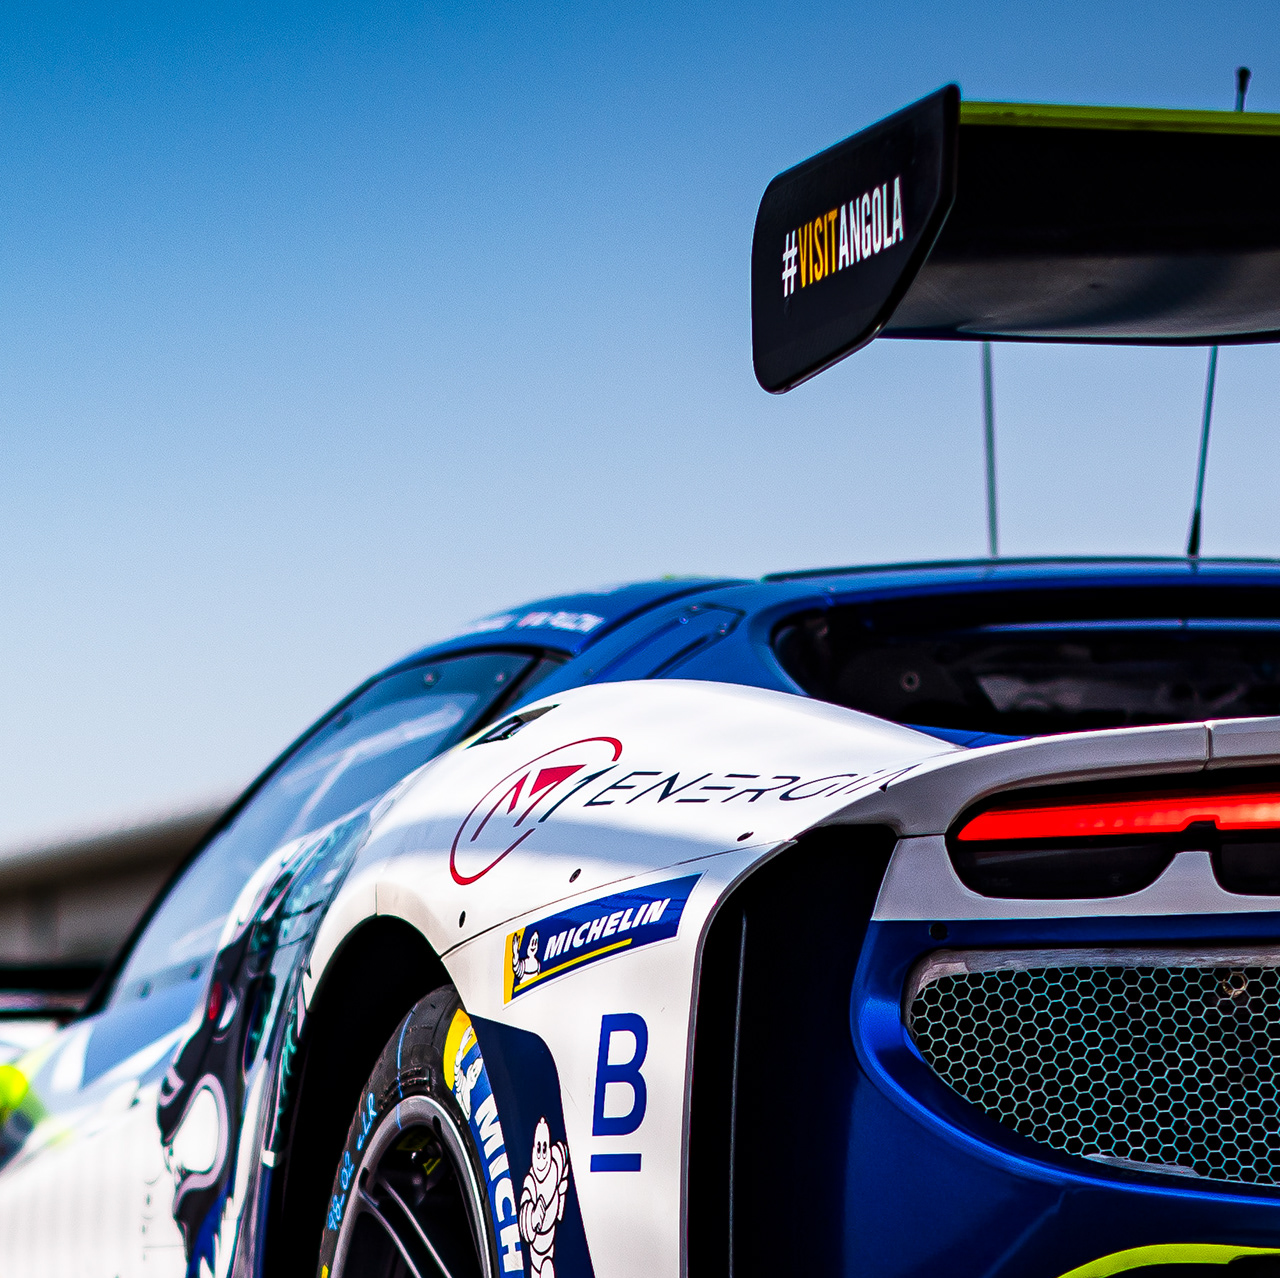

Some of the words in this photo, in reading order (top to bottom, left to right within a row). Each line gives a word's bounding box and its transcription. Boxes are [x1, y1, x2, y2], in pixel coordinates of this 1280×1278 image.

[781, 175, 904, 298] #VISITANGOLA
[542, 897, 671, 962] MICHELIN
[590, 1012, 649, 1137] B
